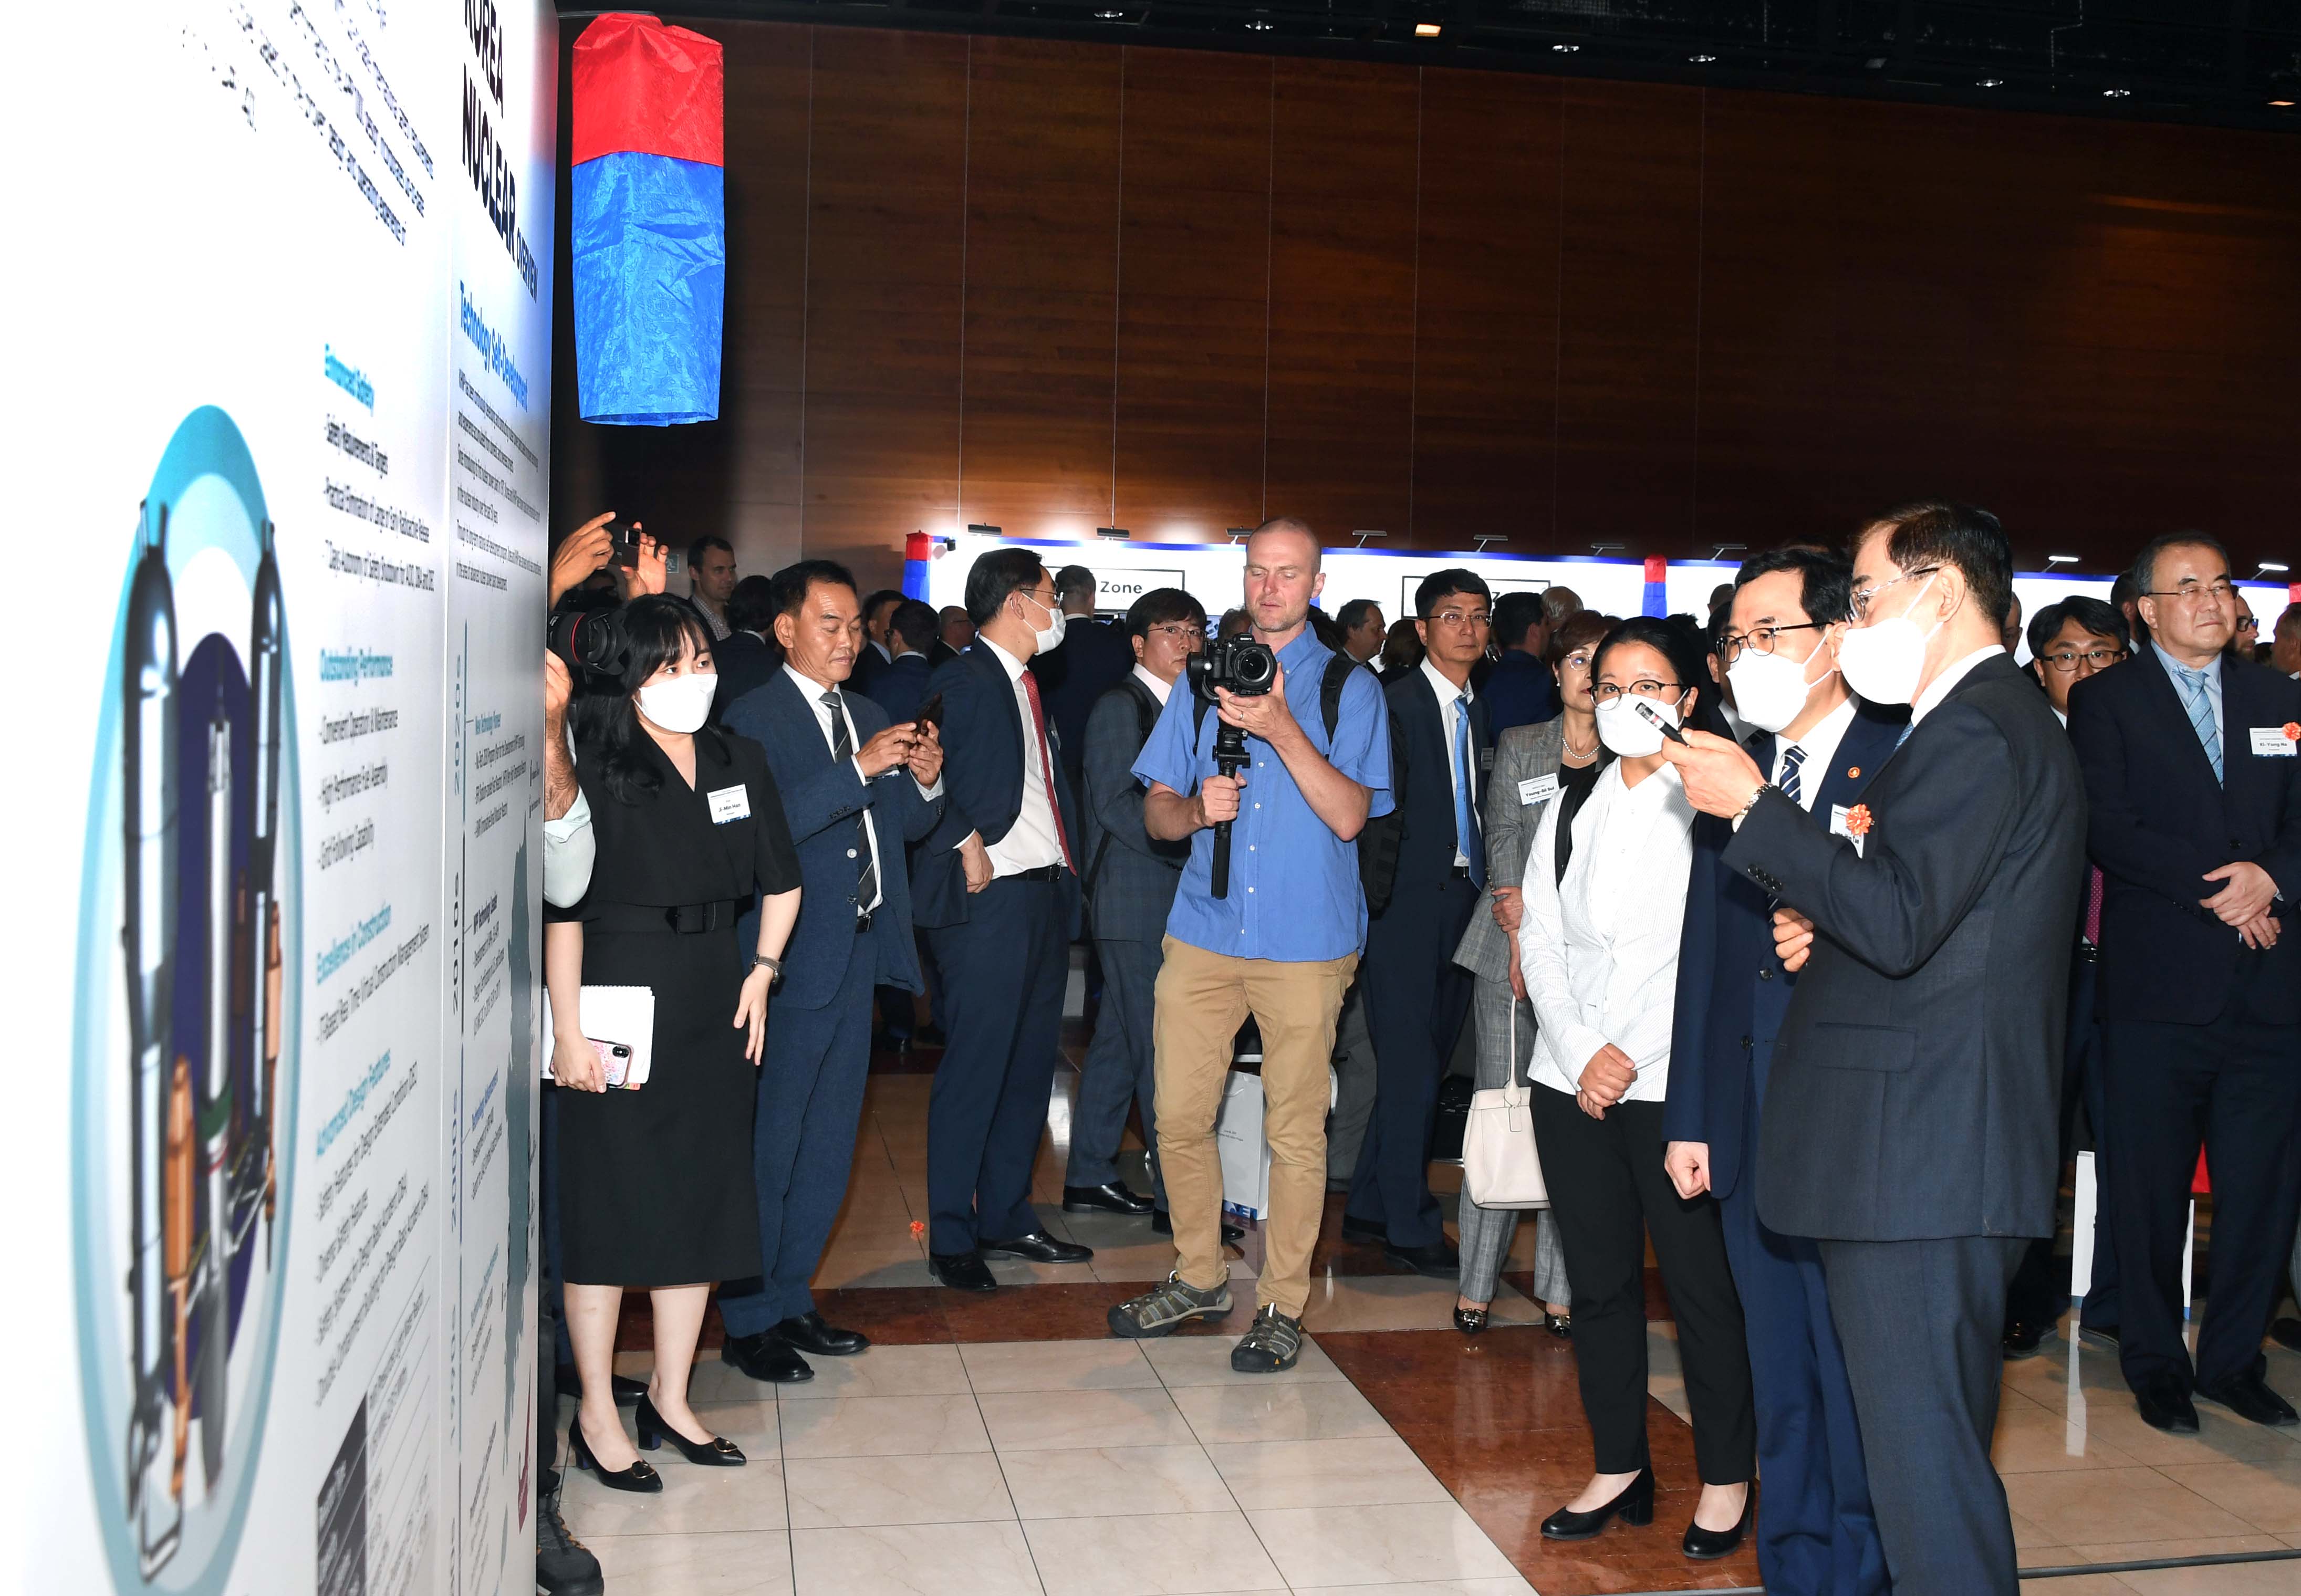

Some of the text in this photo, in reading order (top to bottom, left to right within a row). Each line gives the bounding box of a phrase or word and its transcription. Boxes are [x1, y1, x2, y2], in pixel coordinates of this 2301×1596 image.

[462, 62, 538, 304] NUCLEAR OVERVIEW
[460, 280, 491, 373] Technology
[492, 327, 528, 413] Self-Development
[1100, 581, 1142, 593] Zone
